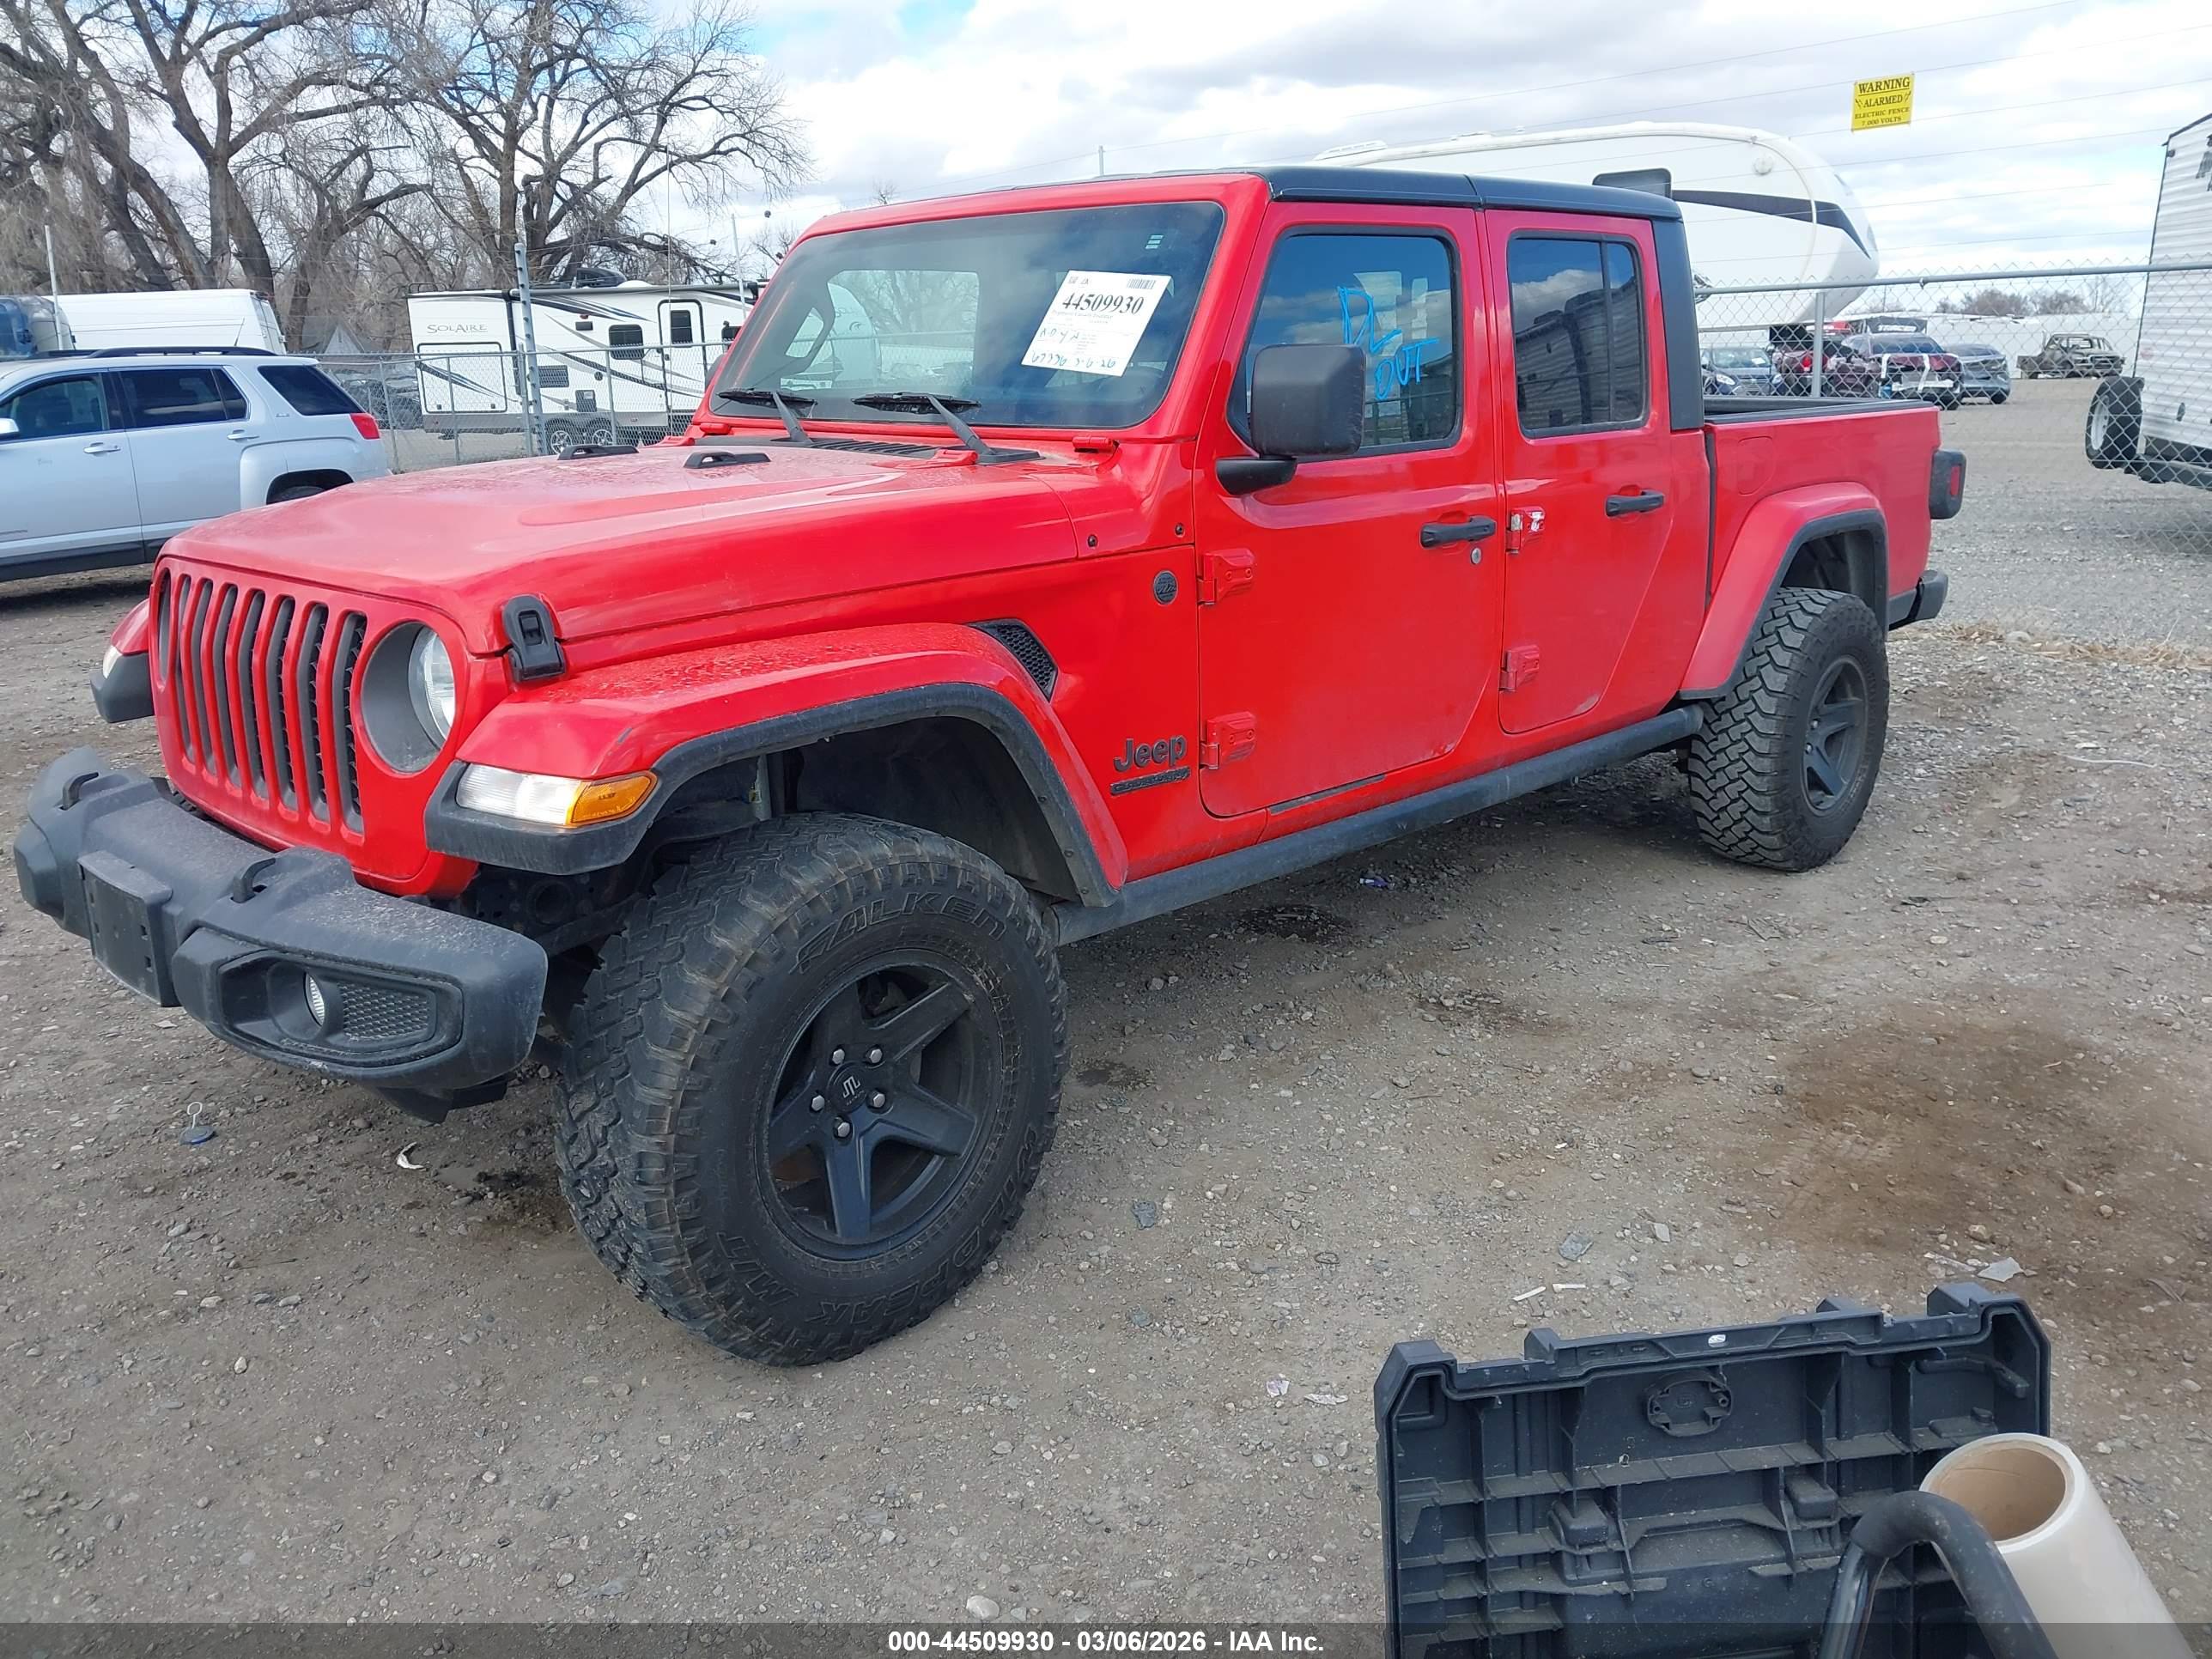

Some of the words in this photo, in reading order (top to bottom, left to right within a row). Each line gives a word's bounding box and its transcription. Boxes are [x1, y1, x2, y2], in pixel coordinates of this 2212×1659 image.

[1858, 77, 1910, 94] WARNING
[1863, 94, 1903, 107] ALARMED
[1855, 110, 1887, 119] ELECTRIC
[1062, 292, 1145, 314] 44509930
[1374, 337, 1439, 399] OUT
[1113, 735, 1187, 772] Jeep
[788, 891, 1007, 975] FALKEN
